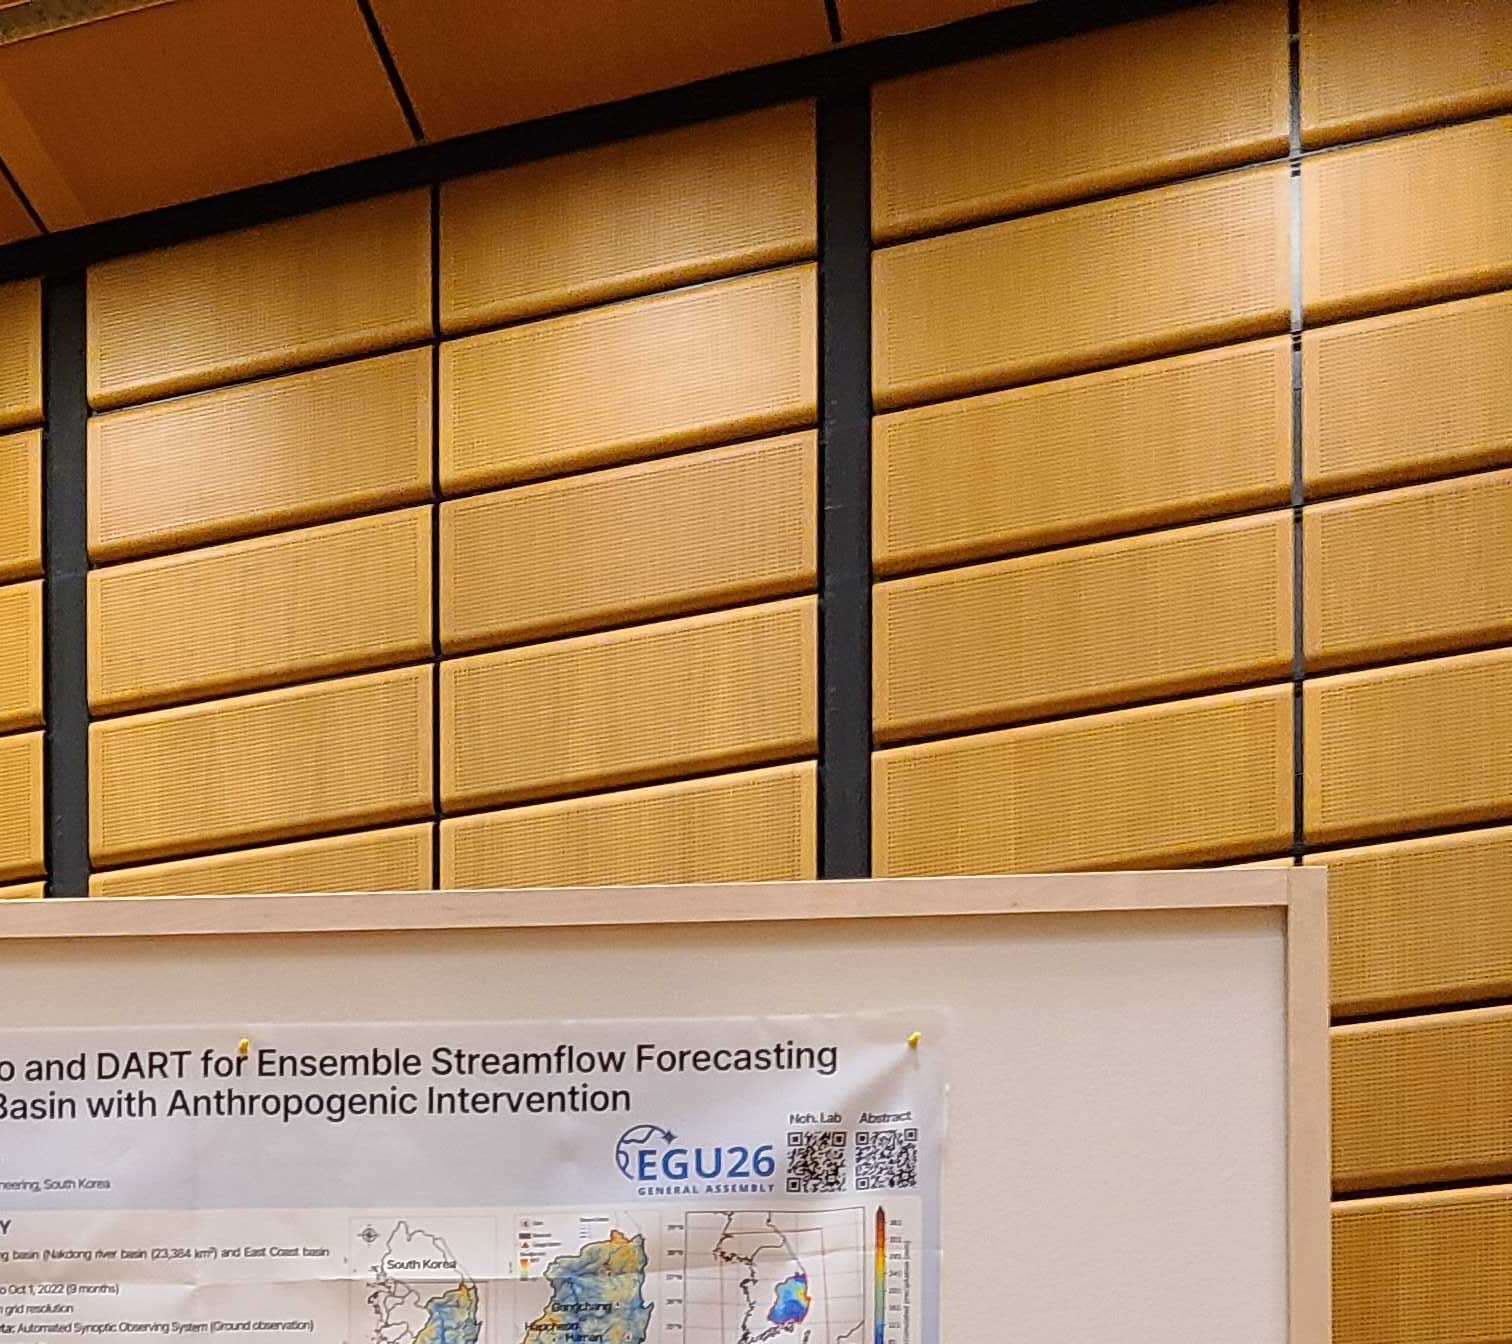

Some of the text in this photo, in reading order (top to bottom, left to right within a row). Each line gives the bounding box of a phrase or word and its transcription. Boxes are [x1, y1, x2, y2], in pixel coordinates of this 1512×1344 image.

[25, 1053, 86, 1081] and
[96, 1051, 191, 1079] DART
[200, 1048, 248, 1077] for
[259, 1048, 421, 1076] Ensemble
[431, 1045, 626, 1075] Streamflow
[636, 1041, 838, 1075] Forecasting
[87, 1090, 158, 1117] with
[166, 1086, 418, 1122] Anthropogenic
[427, 1083, 632, 1113] Intervention
[821, 1112, 841, 1123] Lab
[860, 1112, 911, 1124] Abstract
[638, 1145, 774, 1181] EGU26
[638, 1184, 774, 1195] GENERAL ASSEMBLY
[388, 1259, 456, 1270] South Korea
